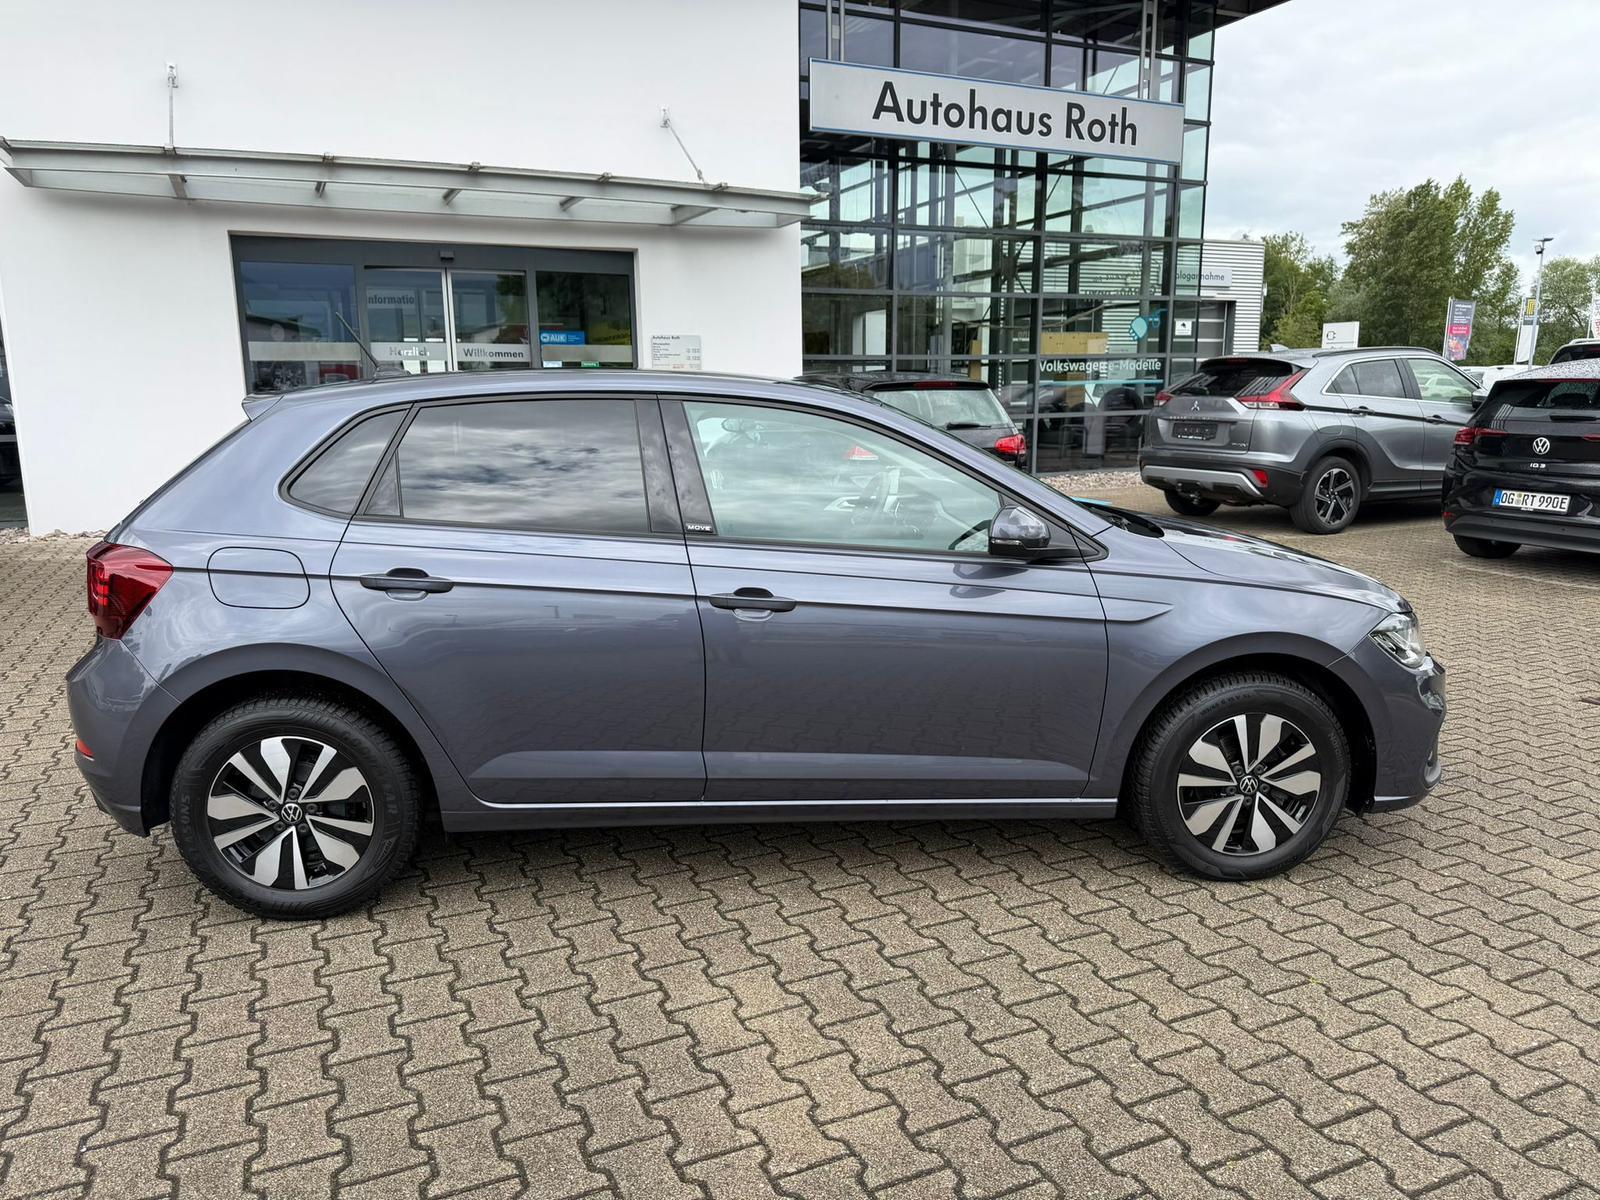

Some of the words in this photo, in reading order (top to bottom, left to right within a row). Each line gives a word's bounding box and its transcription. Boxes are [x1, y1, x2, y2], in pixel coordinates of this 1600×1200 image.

[872, 80, 1052, 138] Autohaus
[1065, 102, 1138, 146] Roth
[1176, 270, 1225, 282] alogannahme
[368, 294, 416, 305] nformatio
[463, 348, 524, 358] Willkommen
[1501, 492, 1516, 505] OG
[1521, 494, 1537, 507] RT
[1538, 495, 1568, 510] 990E
